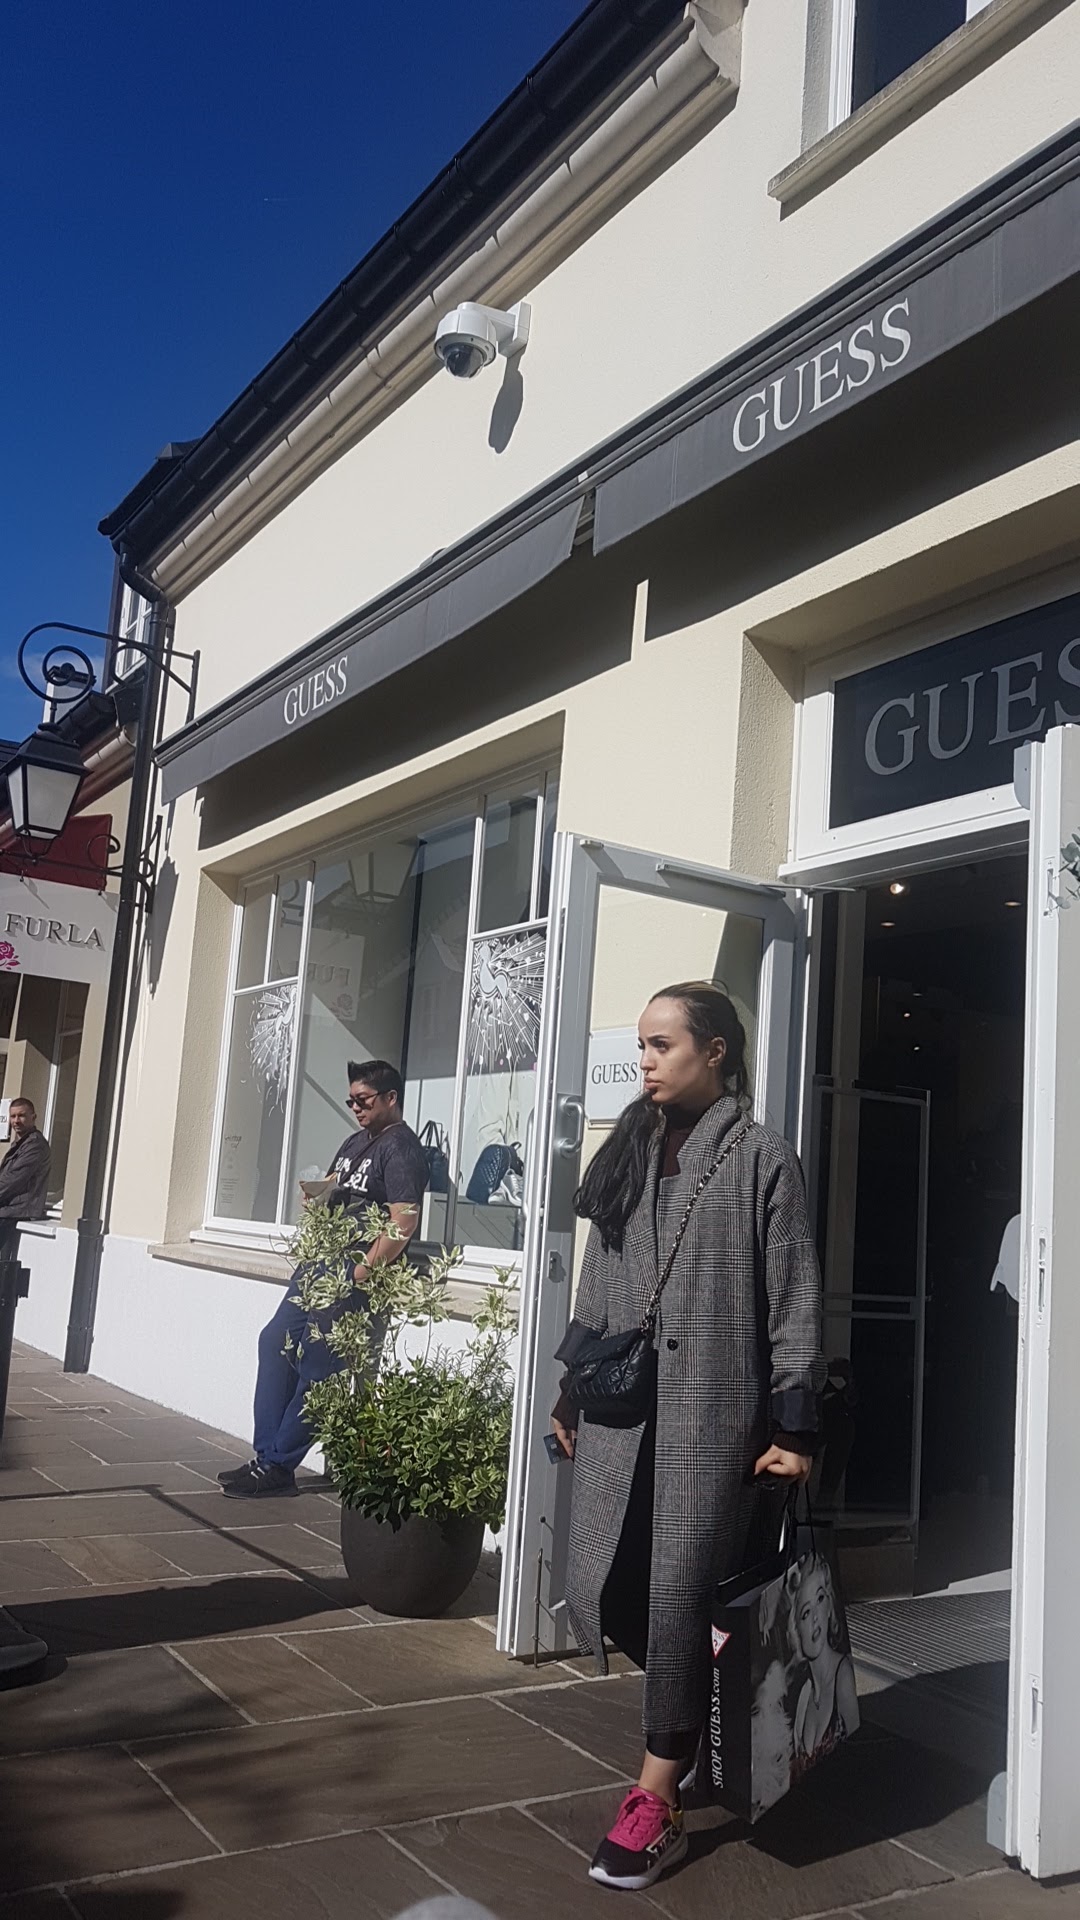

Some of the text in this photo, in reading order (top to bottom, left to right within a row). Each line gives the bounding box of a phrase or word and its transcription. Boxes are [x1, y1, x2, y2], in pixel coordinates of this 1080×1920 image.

[732, 297, 912, 452] GUESS
[283, 655, 348, 725] GUESS
[4, 912, 103, 949] FURLA
[591, 1061, 638, 1085] GUESS
[710, 1667, 724, 1788] SHOP GUESS.com
